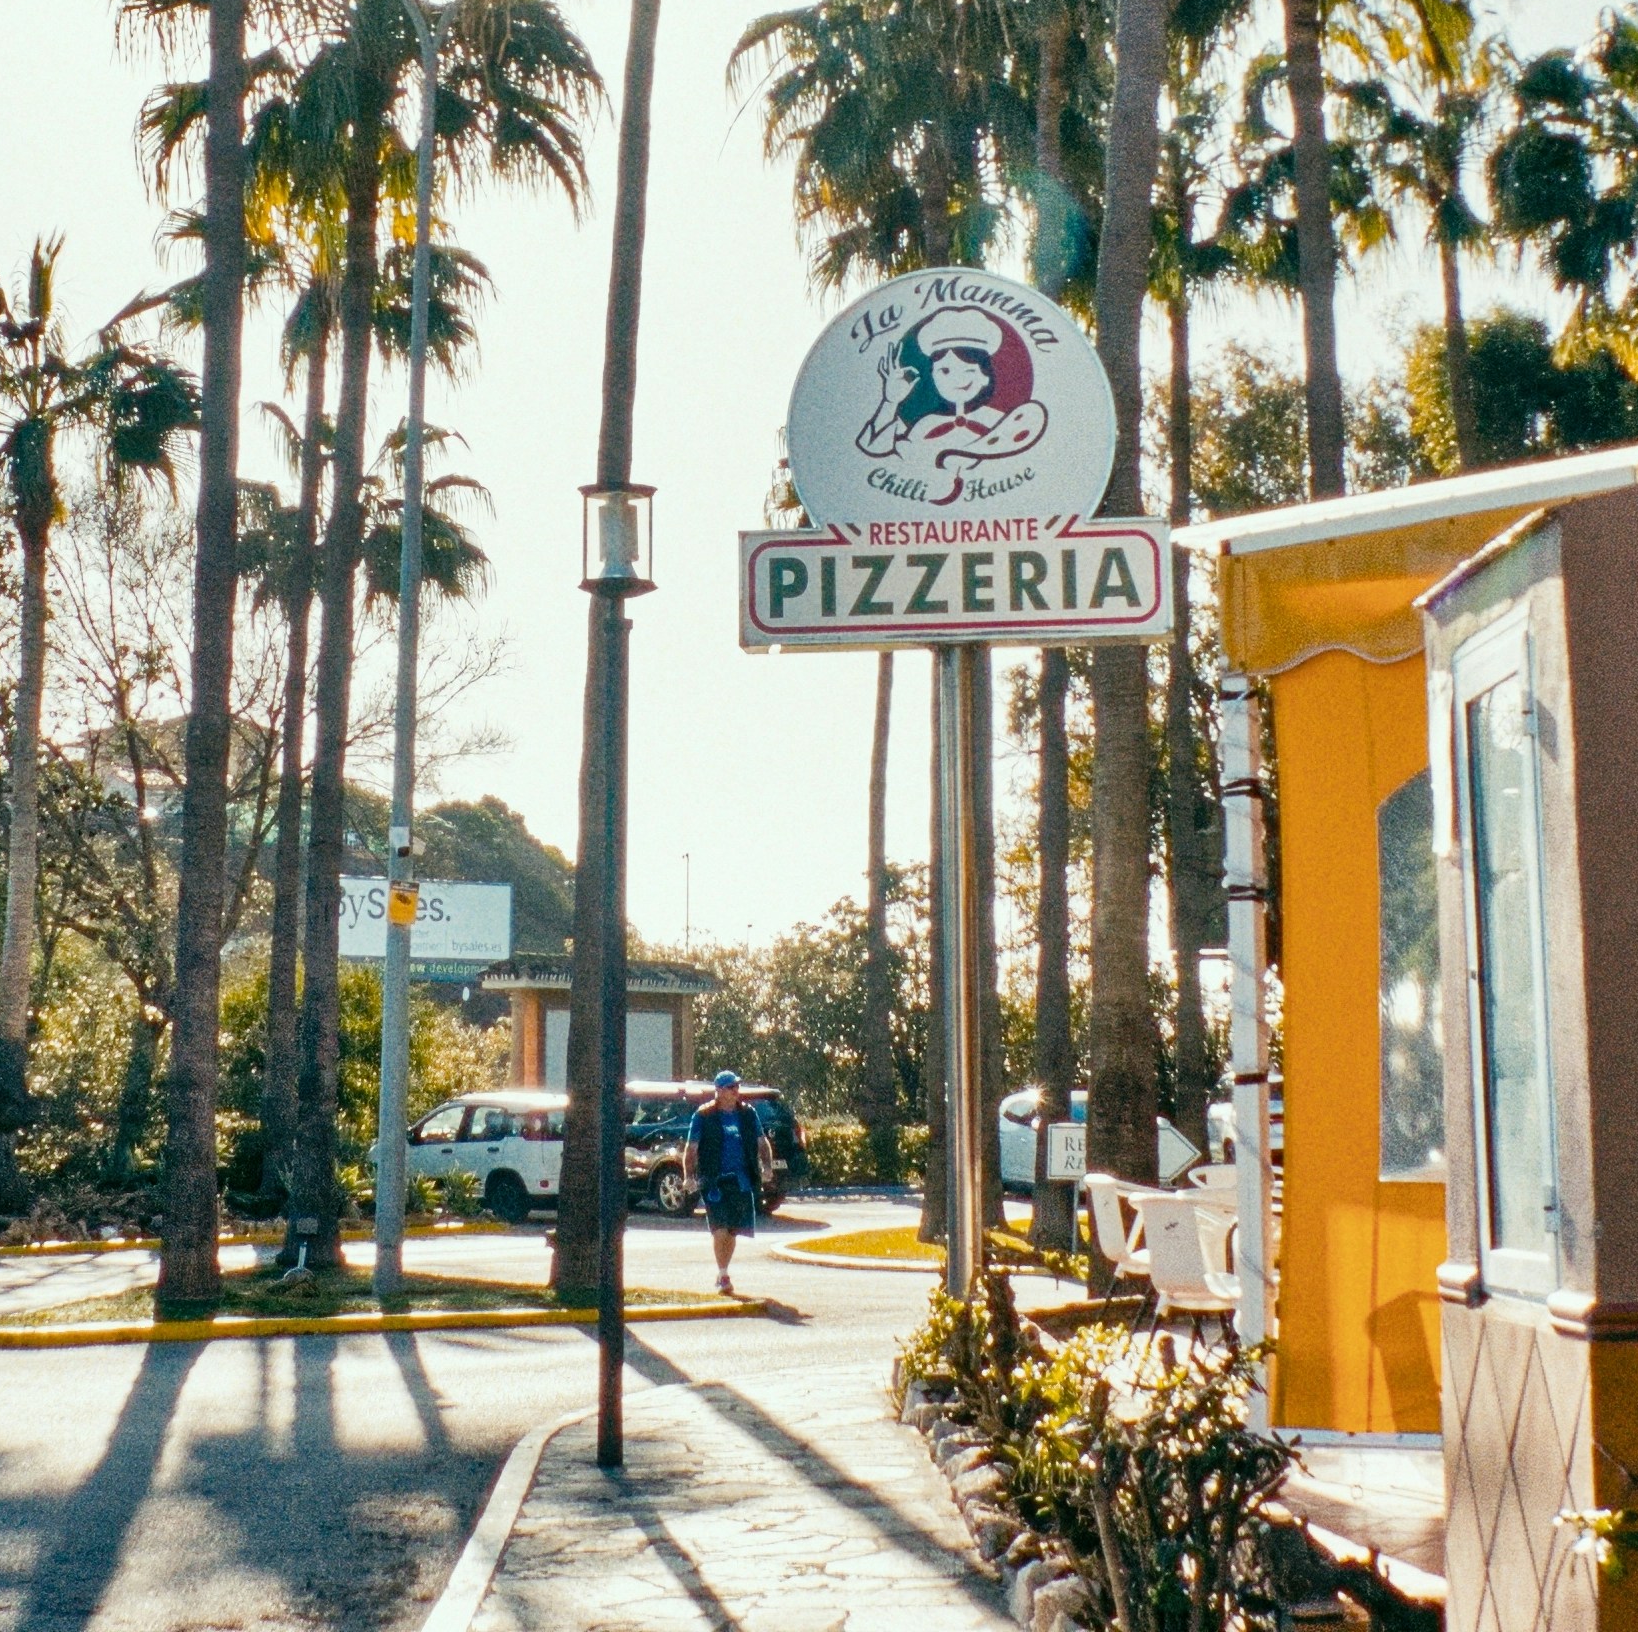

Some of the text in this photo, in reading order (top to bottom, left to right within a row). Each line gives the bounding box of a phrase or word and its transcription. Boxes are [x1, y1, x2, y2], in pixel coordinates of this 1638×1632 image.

[851, 276, 1059, 354] La Mamma
[867, 467, 1035, 502] Chilli House
[870, 518, 1038, 546] RESTAURANTE
[768, 546, 1142, 619] PIZZERIA
